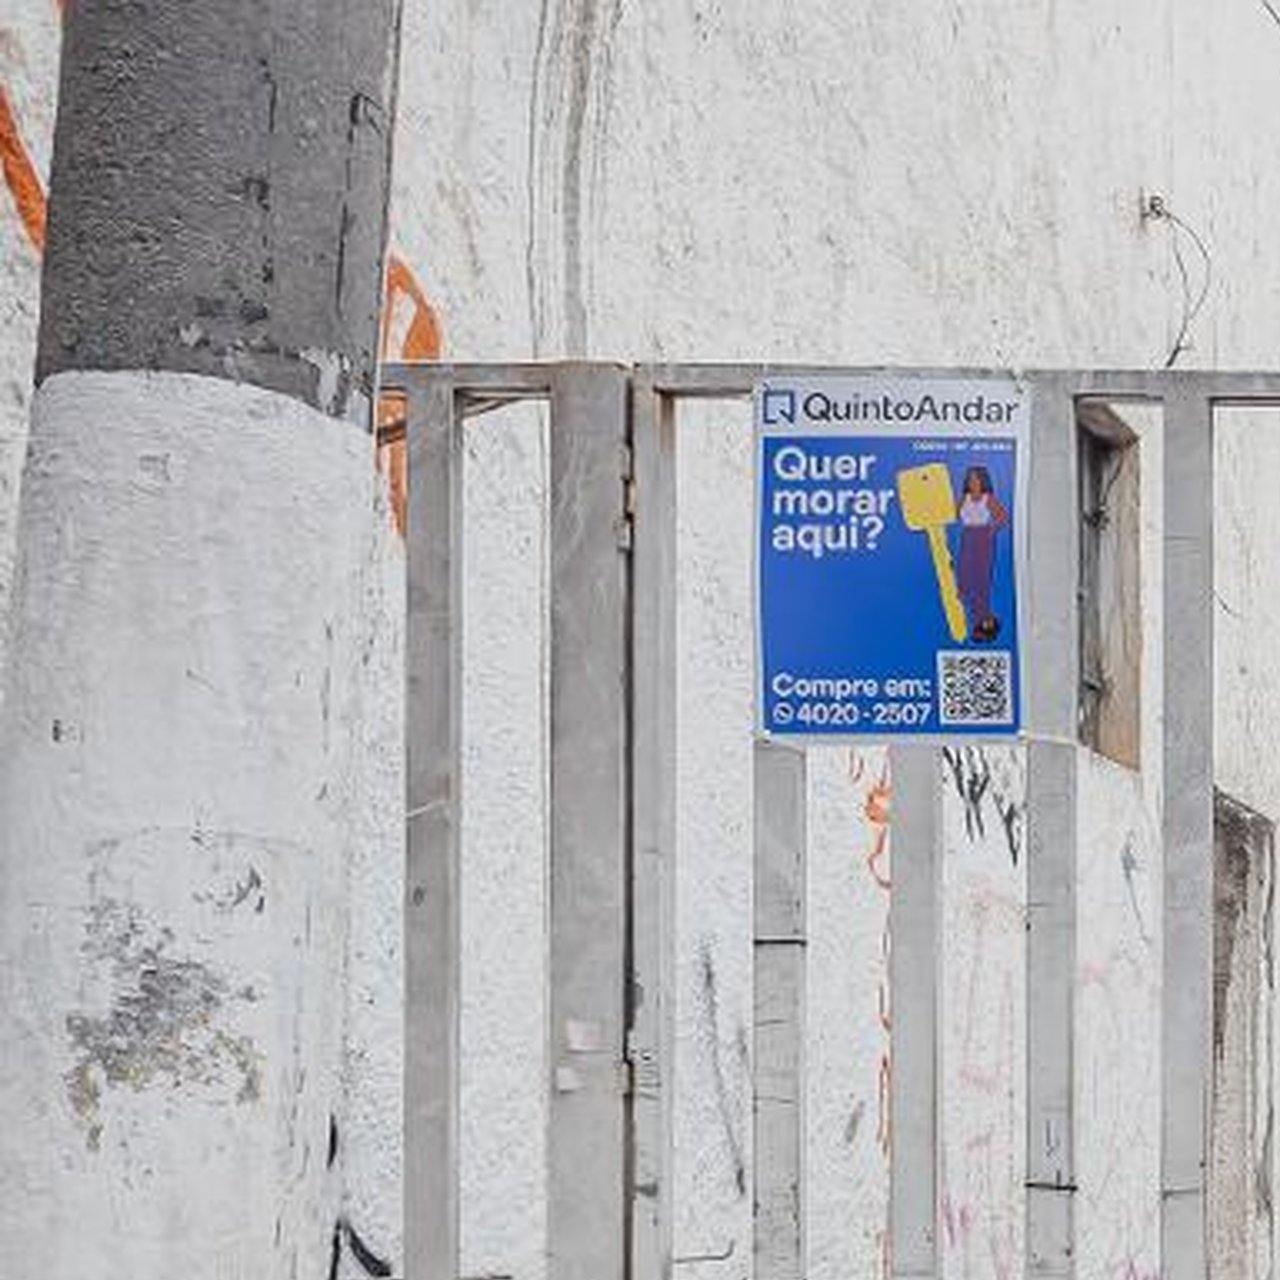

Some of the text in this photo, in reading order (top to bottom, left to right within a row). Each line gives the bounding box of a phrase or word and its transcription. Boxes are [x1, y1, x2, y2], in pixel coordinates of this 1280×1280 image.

[803, 392, 1018, 422] QuintoAndar
[774, 447, 876, 480] Quer
[773, 489, 894, 515] morar
[773, 516, 884, 557] aqui?
[772, 673, 932, 699] Compre em:
